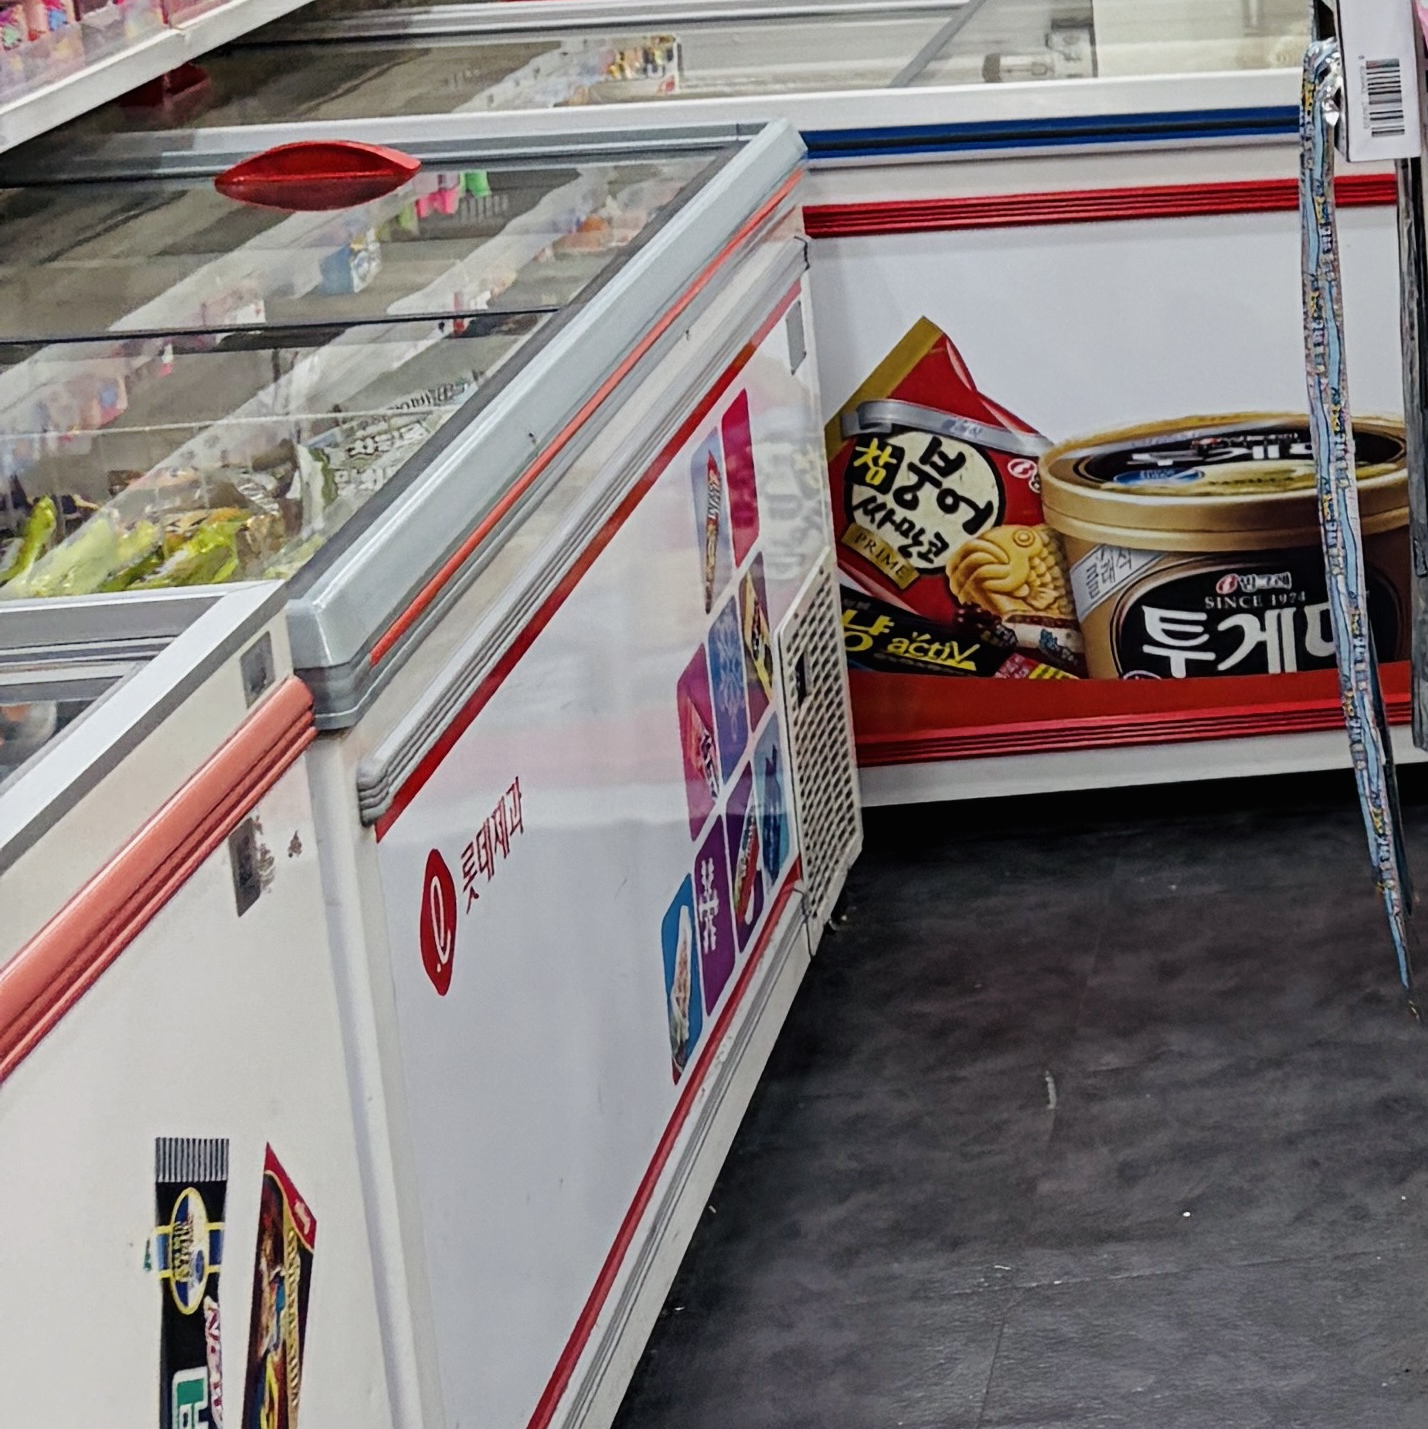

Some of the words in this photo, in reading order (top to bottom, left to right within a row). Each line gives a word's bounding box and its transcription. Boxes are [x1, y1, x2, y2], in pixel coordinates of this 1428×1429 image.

[852, 437, 898, 487] 참
[892, 435, 995, 536] 붕어
[852, 494, 950, 565] 싸만코
[853, 530, 911, 580] PRIME
[1204, 594, 1263, 610] SINCE
